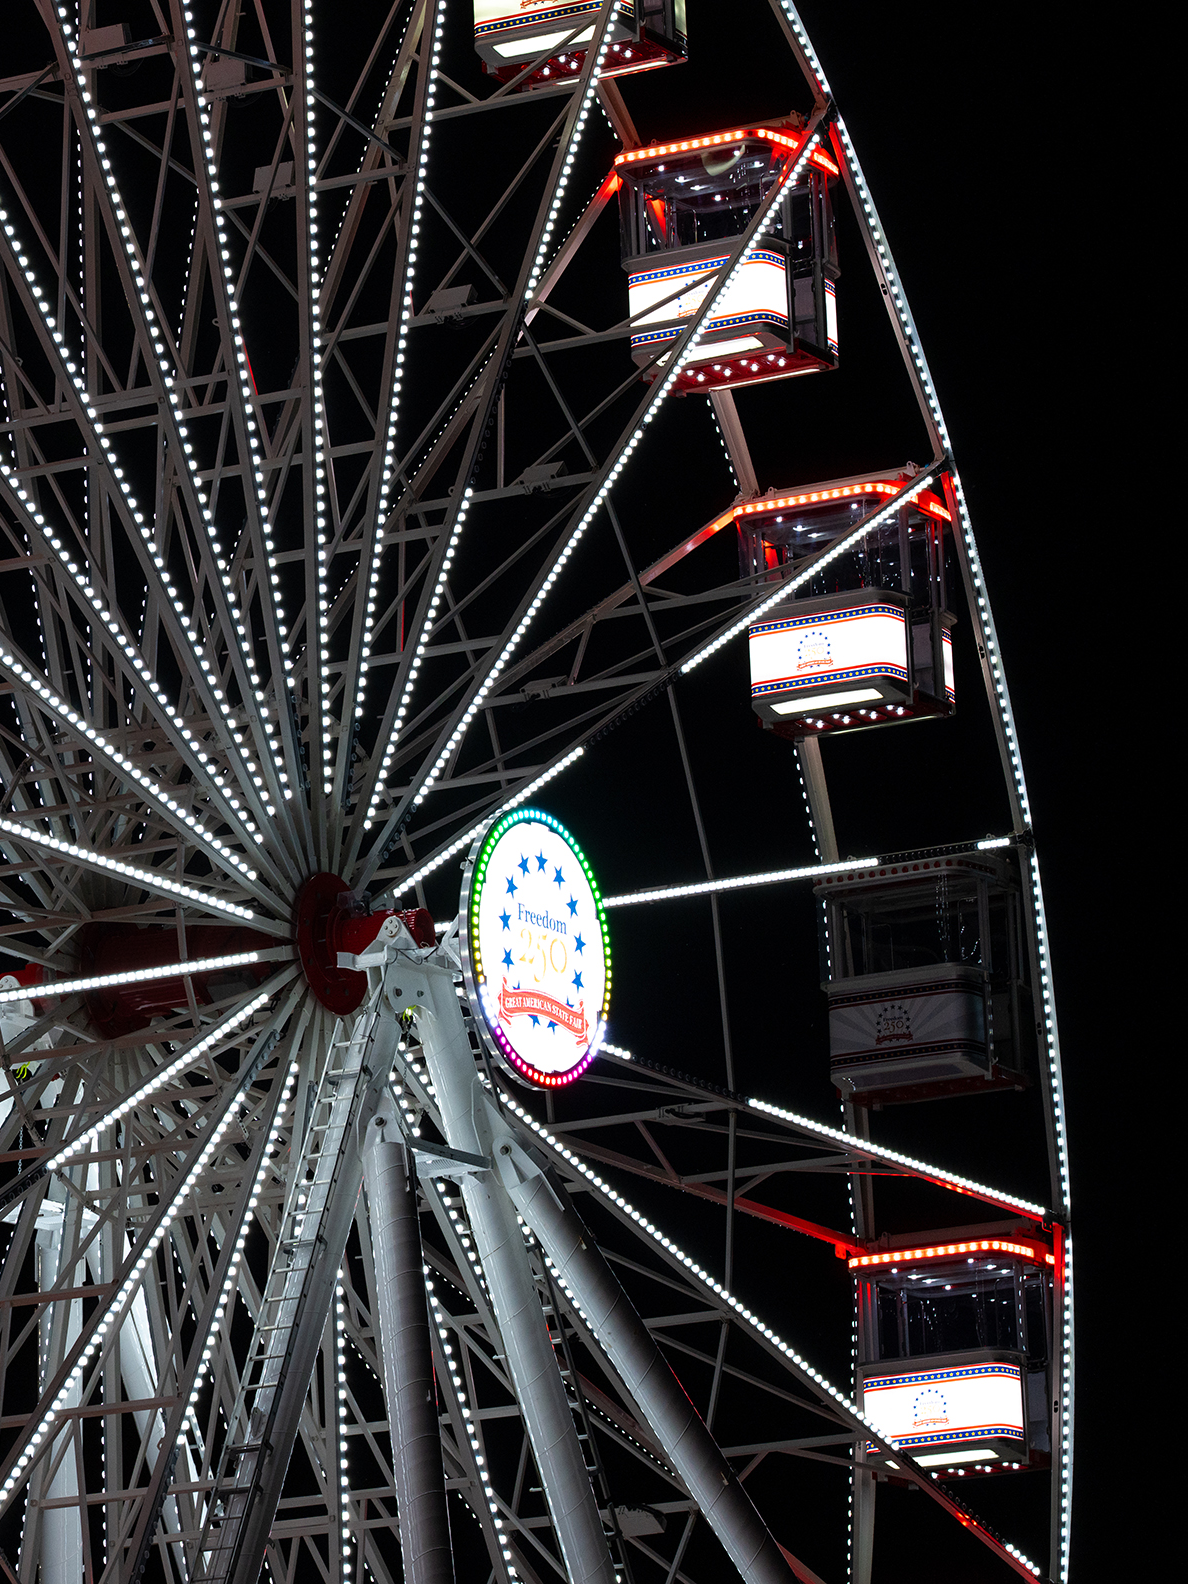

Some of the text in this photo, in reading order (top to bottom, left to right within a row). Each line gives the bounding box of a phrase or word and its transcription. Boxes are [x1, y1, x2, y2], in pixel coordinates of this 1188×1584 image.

[517, 902, 568, 936] Freedom
[518, 928, 568, 983] 250
[505, 996, 583, 1030] GREAT AMERICAN STATE FAIR
[883, 1020, 905, 1034] 250
